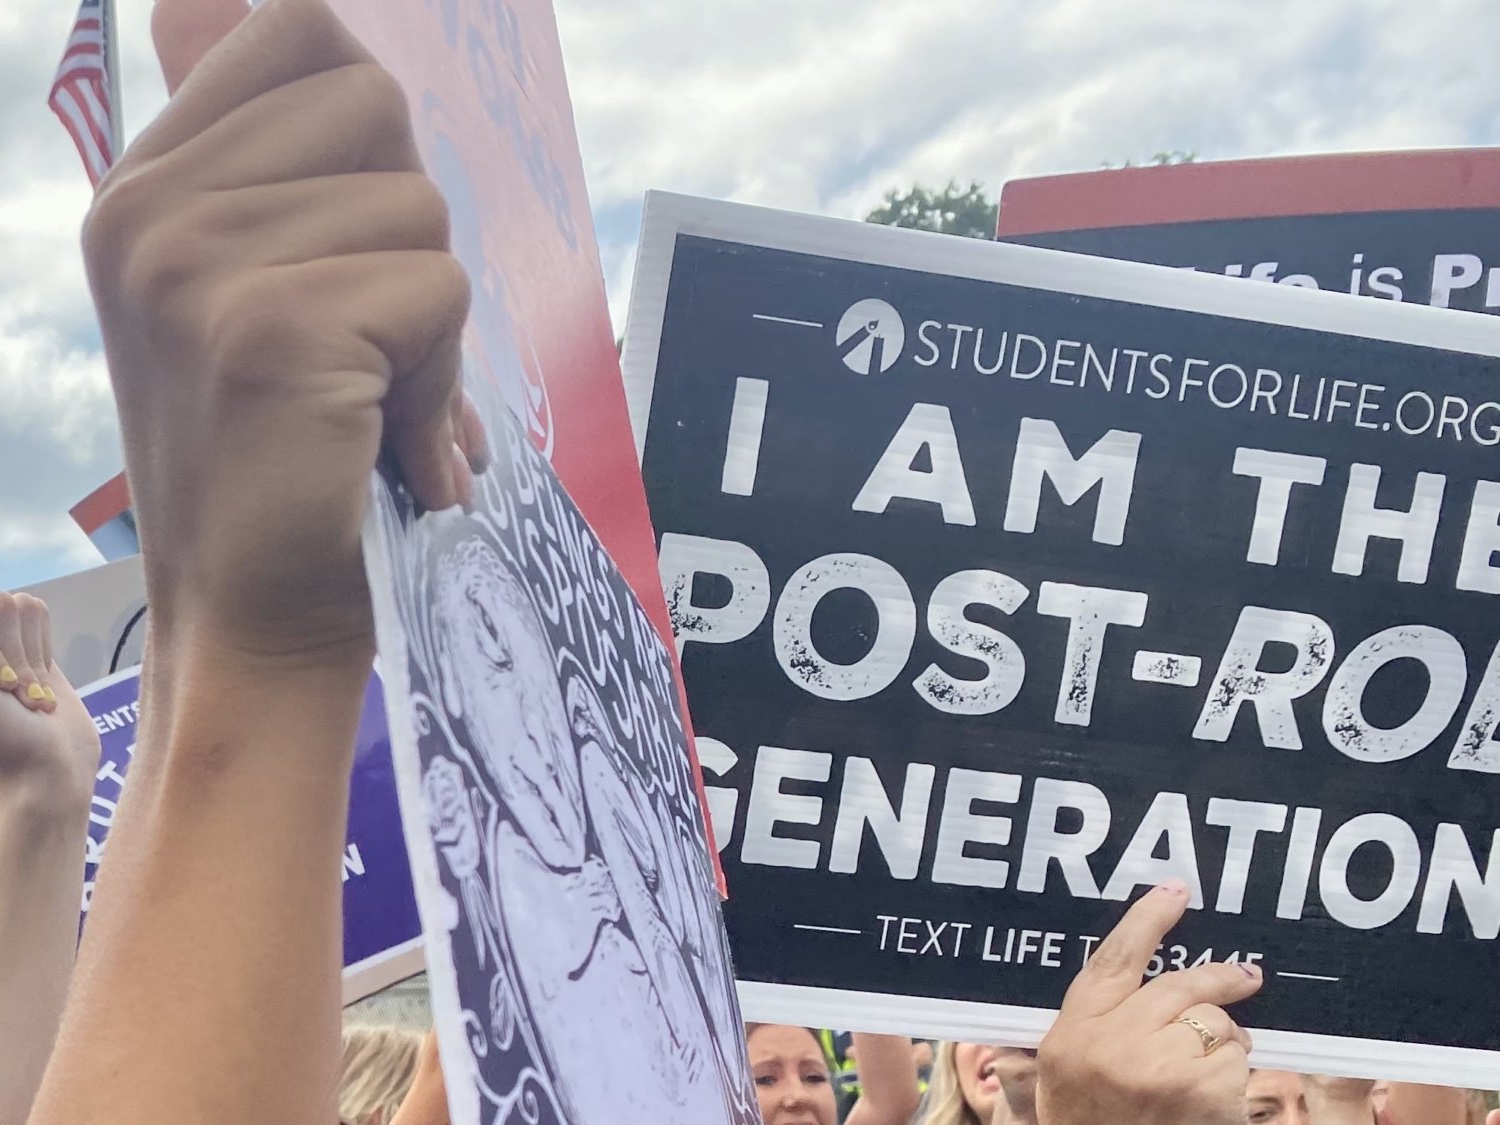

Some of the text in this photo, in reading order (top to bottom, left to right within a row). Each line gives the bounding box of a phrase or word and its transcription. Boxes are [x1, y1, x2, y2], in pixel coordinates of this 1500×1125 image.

[721, 376, 769, 497] I
[851, 402, 1143, 547] AM
[876, 914, 972, 958] TEXT
[982, 926, 1066, 968] LIFE
